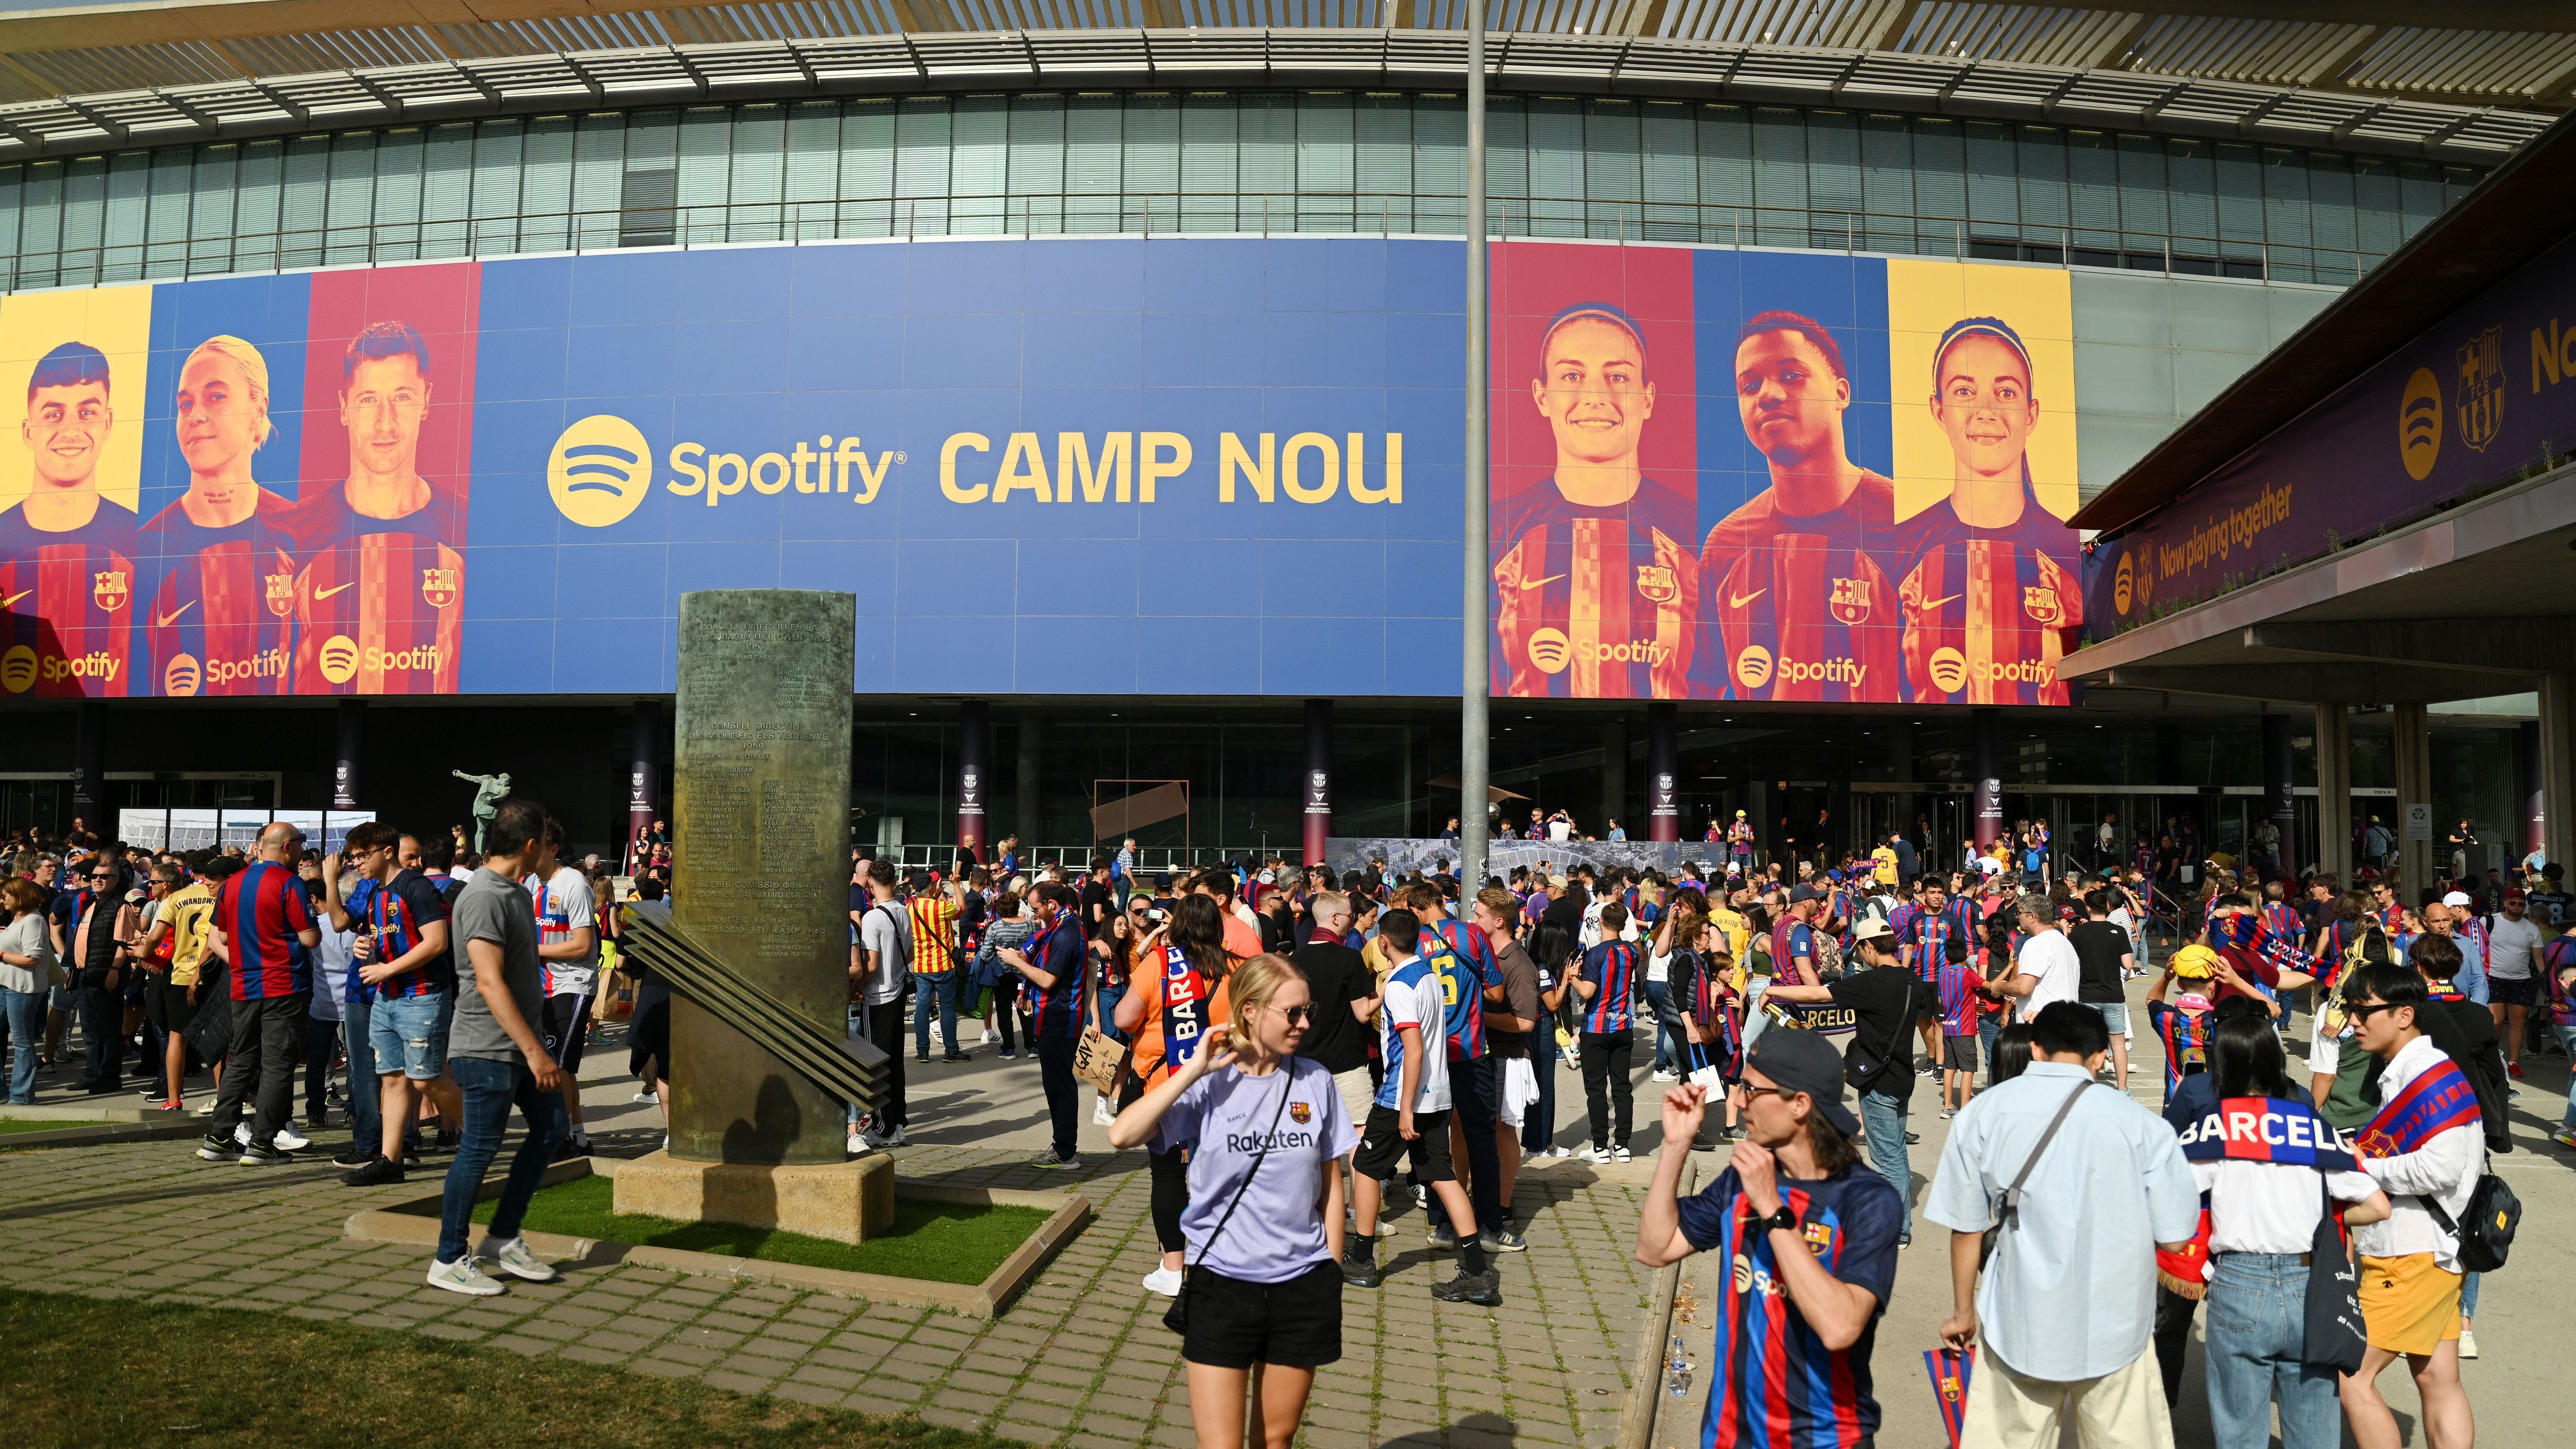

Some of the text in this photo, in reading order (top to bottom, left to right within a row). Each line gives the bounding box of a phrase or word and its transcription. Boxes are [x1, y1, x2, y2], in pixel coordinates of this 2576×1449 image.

[2471, 379, 2489, 400] FCB
[940, 431, 1402, 504] CAMP NOU
[2160, 482, 2292, 581] Now playing together
[701, 623, 741, 631] CONSELL
[790, 623, 803, 632] EN
[754, 633, 774, 641] DEL
[776, 633, 807, 641] CAMP
[745, 642, 767, 651] 1957
[1577, 638, 1670, 668] Spotify
[363, 645, 444, 674] Spotify
[42, 651, 120, 682] Spotify
[206, 648, 291, 686] Spotify
[1777, 656, 1867, 687] Spotify
[1973, 658, 2055, 688] Spotify
[711, 722, 799, 730] CONSELL DIRECTIU
[689, 731, 829, 741] QUE ADQUIREIX ELS TERRENYS
[743, 741, 765, 750] 1950
[734, 878, 780, 889] COMISSIÓ
[724, 891, 736, 899] DE
[738, 891, 750, 899] LA
[705, 915, 799, 925] ARQUITECTES DE LA
[1714, 919, 1738, 928] ARAUJO
[378, 923, 401, 935] Sotify
[749, 926, 768, 934] DEL
[772, 926, 801, 935] CAMP
[2173, 1026, 2210, 1040] PEDRI
[1090, 1068, 1106, 1087] You
[1099, 1049, 1109, 1058] the
[1227, 1112, 1247, 1123] BARÇA
[1227, 1130, 1313, 1154] Rakuten
[2337, 1316, 2346, 1324] 20
